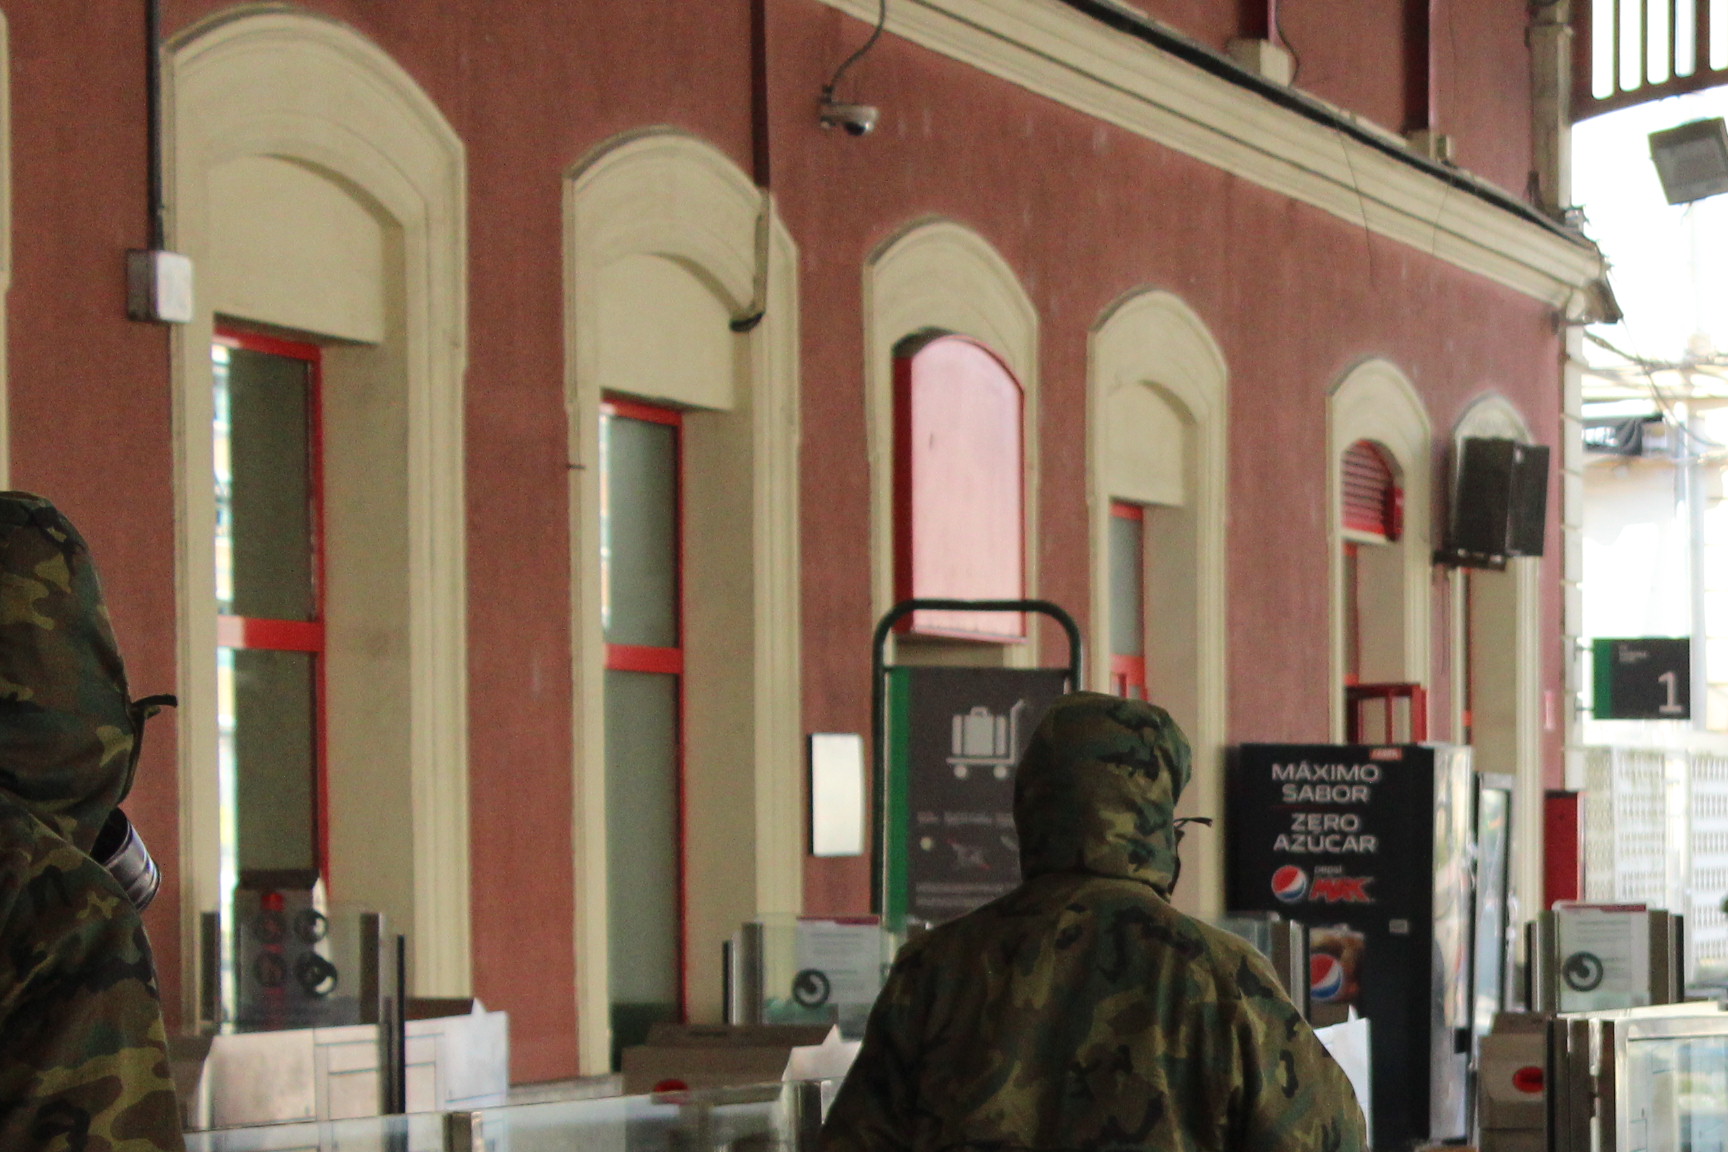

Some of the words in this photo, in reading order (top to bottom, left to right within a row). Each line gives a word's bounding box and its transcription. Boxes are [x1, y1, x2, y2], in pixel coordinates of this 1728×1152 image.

[1657, 671, 1684, 713] 1
[1271, 760, 1381, 782] MÁXIMO
[1282, 783, 1371, 804] SABOR
[1290, 812, 1361, 833] ZERO
